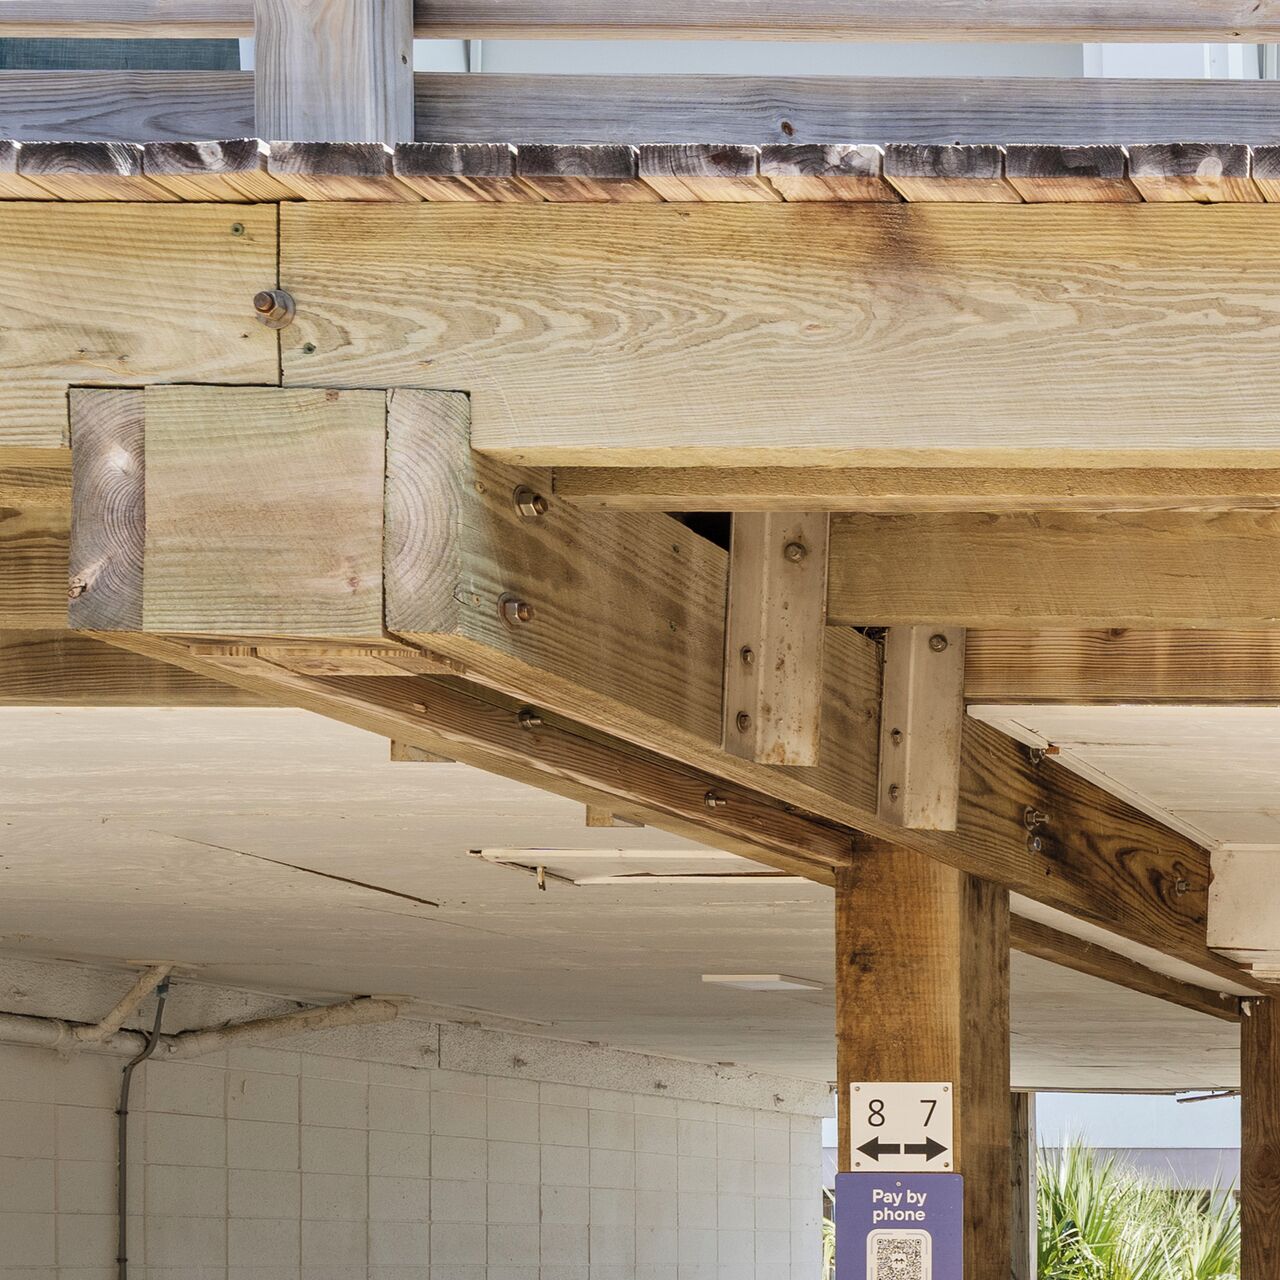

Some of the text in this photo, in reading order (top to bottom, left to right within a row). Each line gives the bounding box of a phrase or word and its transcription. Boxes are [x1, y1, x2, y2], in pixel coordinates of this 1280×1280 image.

[868, 1099, 937, 1127] 8 7
[873, 1189, 927, 1206] Pay by
[873, 1207, 926, 1224] phone
